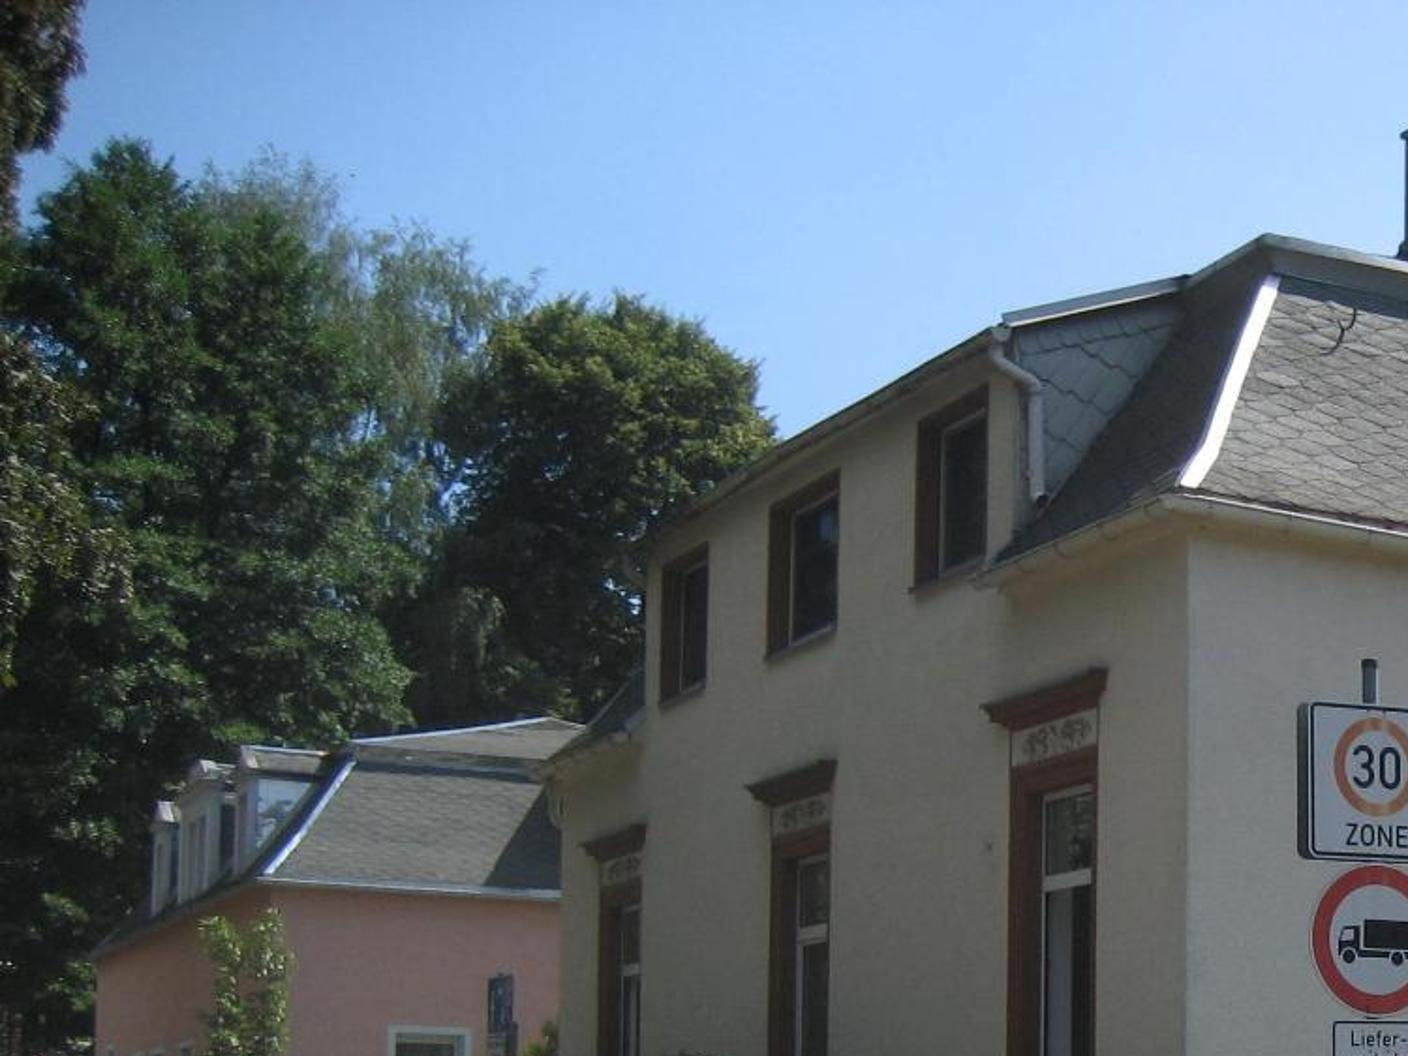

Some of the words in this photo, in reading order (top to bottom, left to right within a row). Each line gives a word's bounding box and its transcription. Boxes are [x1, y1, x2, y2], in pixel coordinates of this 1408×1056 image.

[1351, 744, 1403, 791] 30
[1345, 823, 1408, 849] ZONE
[1350, 1030, 1408, 1048] Liefer-
